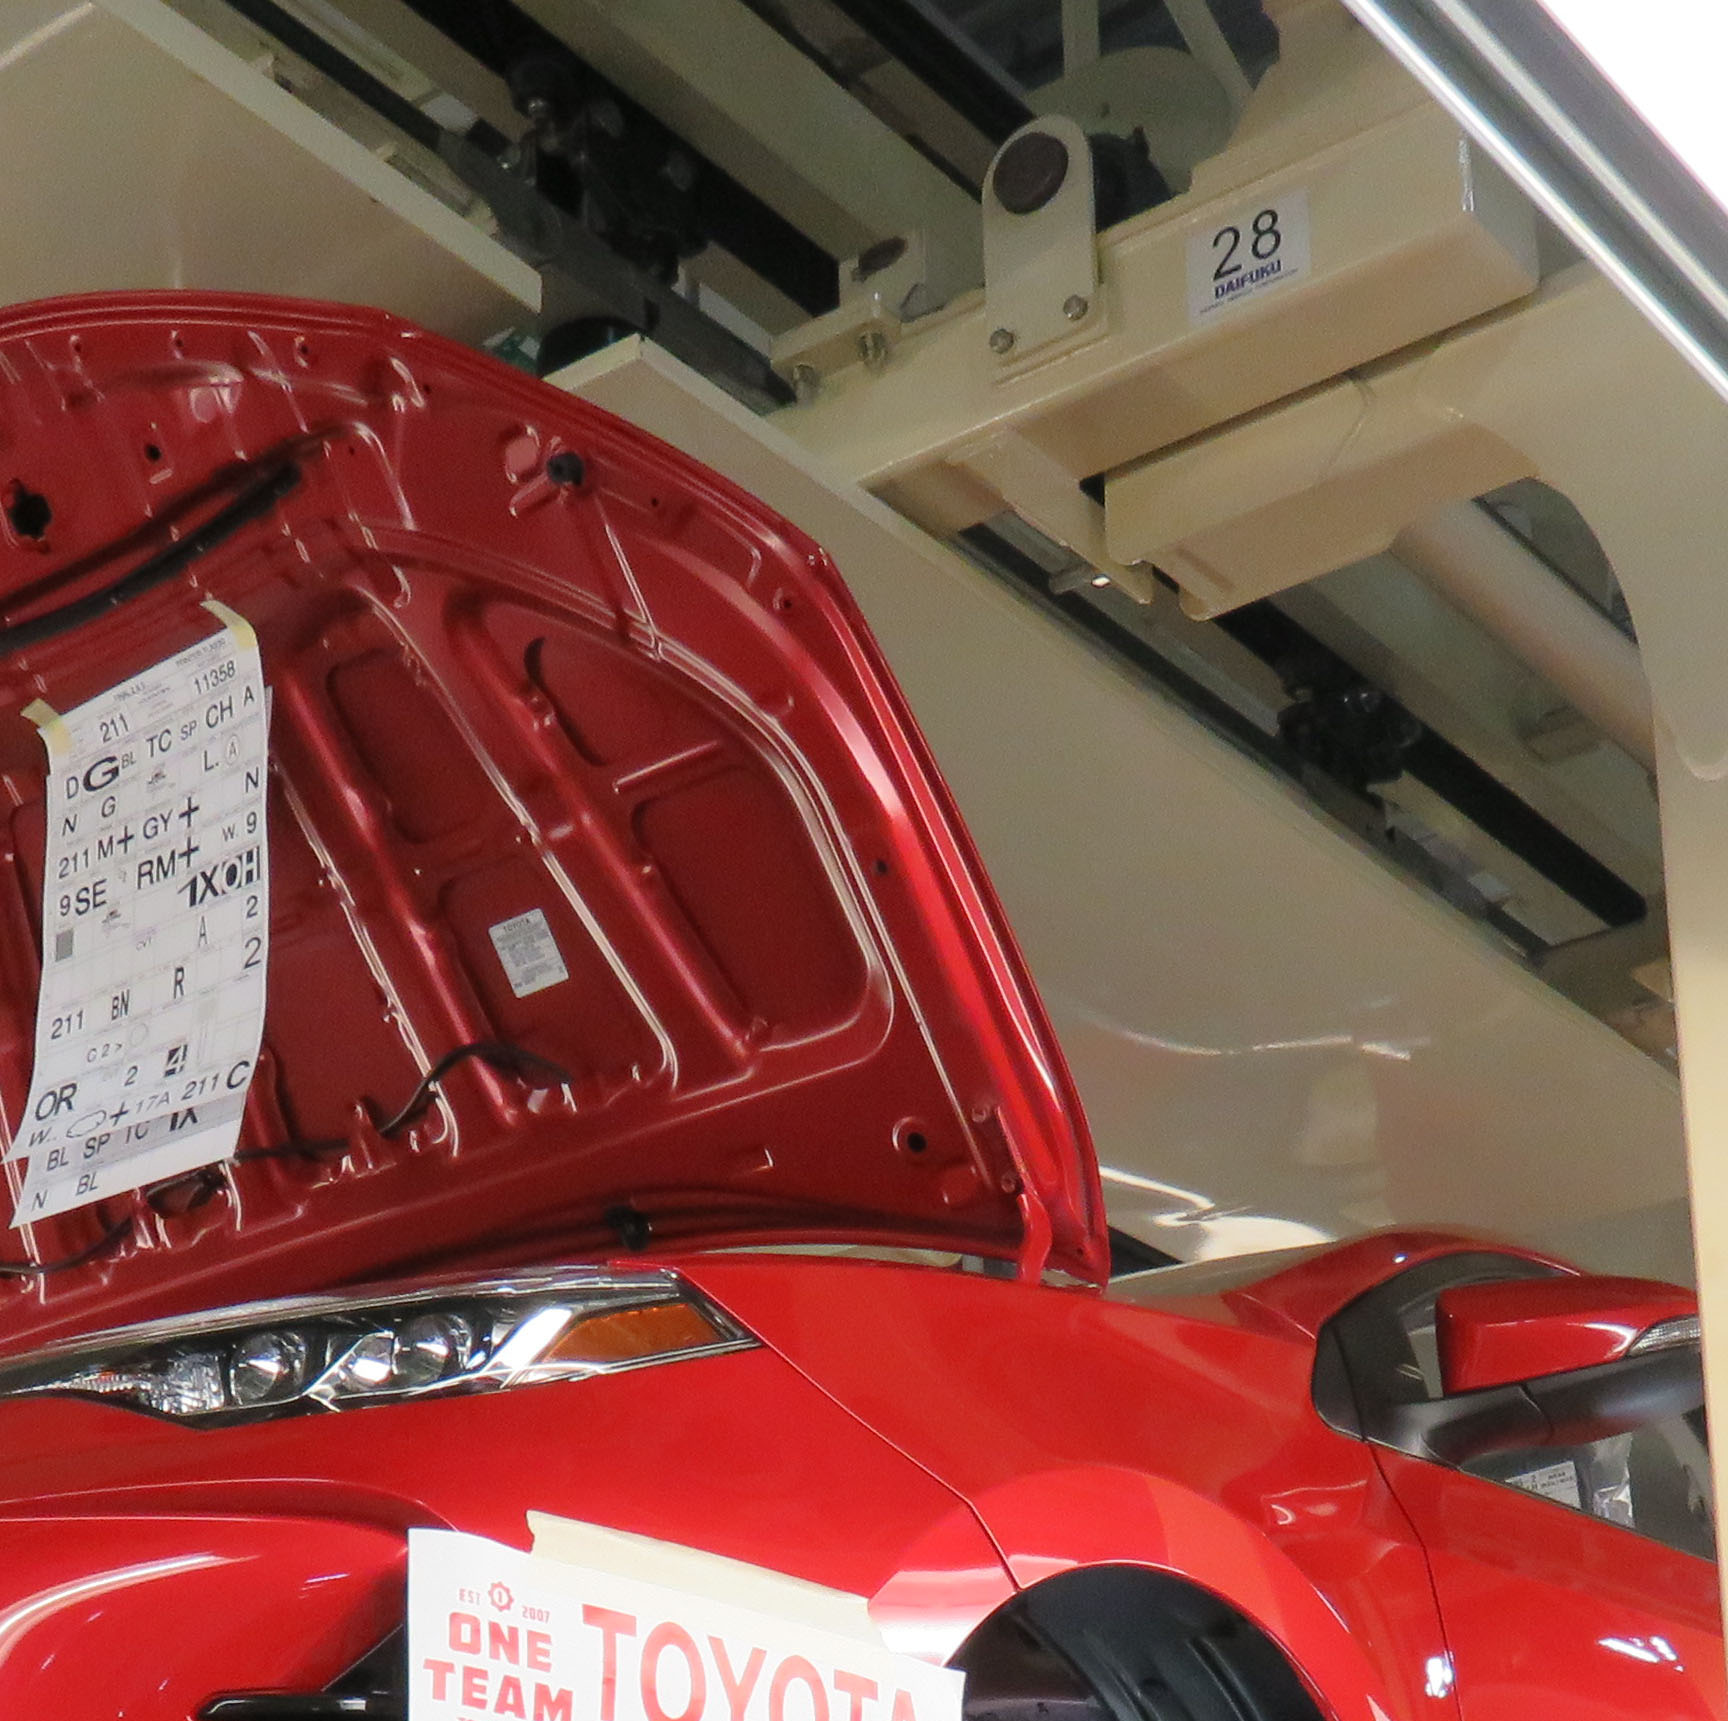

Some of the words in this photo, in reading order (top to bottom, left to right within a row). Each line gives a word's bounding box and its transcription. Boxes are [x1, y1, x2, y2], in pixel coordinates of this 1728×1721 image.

[1213, 209, 1281, 281] 28
[1215, 259, 1282, 299] DAIFUKU
[100, 713, 129, 743] 211
[194, 659, 236, 695] 11358
[82, 756, 120, 792] G
[146, 729, 172, 758] TC
[180, 720, 198, 741] SP
[206, 696, 234, 729] CH
[243, 686, 255, 707] A
[62, 814, 77, 836] N
[101, 796, 115, 818] G
[246, 767, 259, 792] N
[59, 848, 89, 879] 211
[246, 811, 257, 834] 9
[246, 895, 258, 919] 2
[244, 937, 262, 969] 2
[51, 1009, 84, 1040] 211
[174, 966, 185, 999] R
[35, 1083, 77, 1122] OR
[124, 1065, 138, 1087] 2
[181, 1073, 219, 1101] 211
[226, 1060, 250, 1089] C
[47, 1149, 69, 1171] BL
[83, 1133, 110, 1159] SP
[32, 1190, 48, 1211] N
[76, 1172, 98, 1196] BL
[459, 1588, 481, 1605] EST
[522, 1606, 550, 1623] 2007
[449, 1611, 552, 1673] ONE
